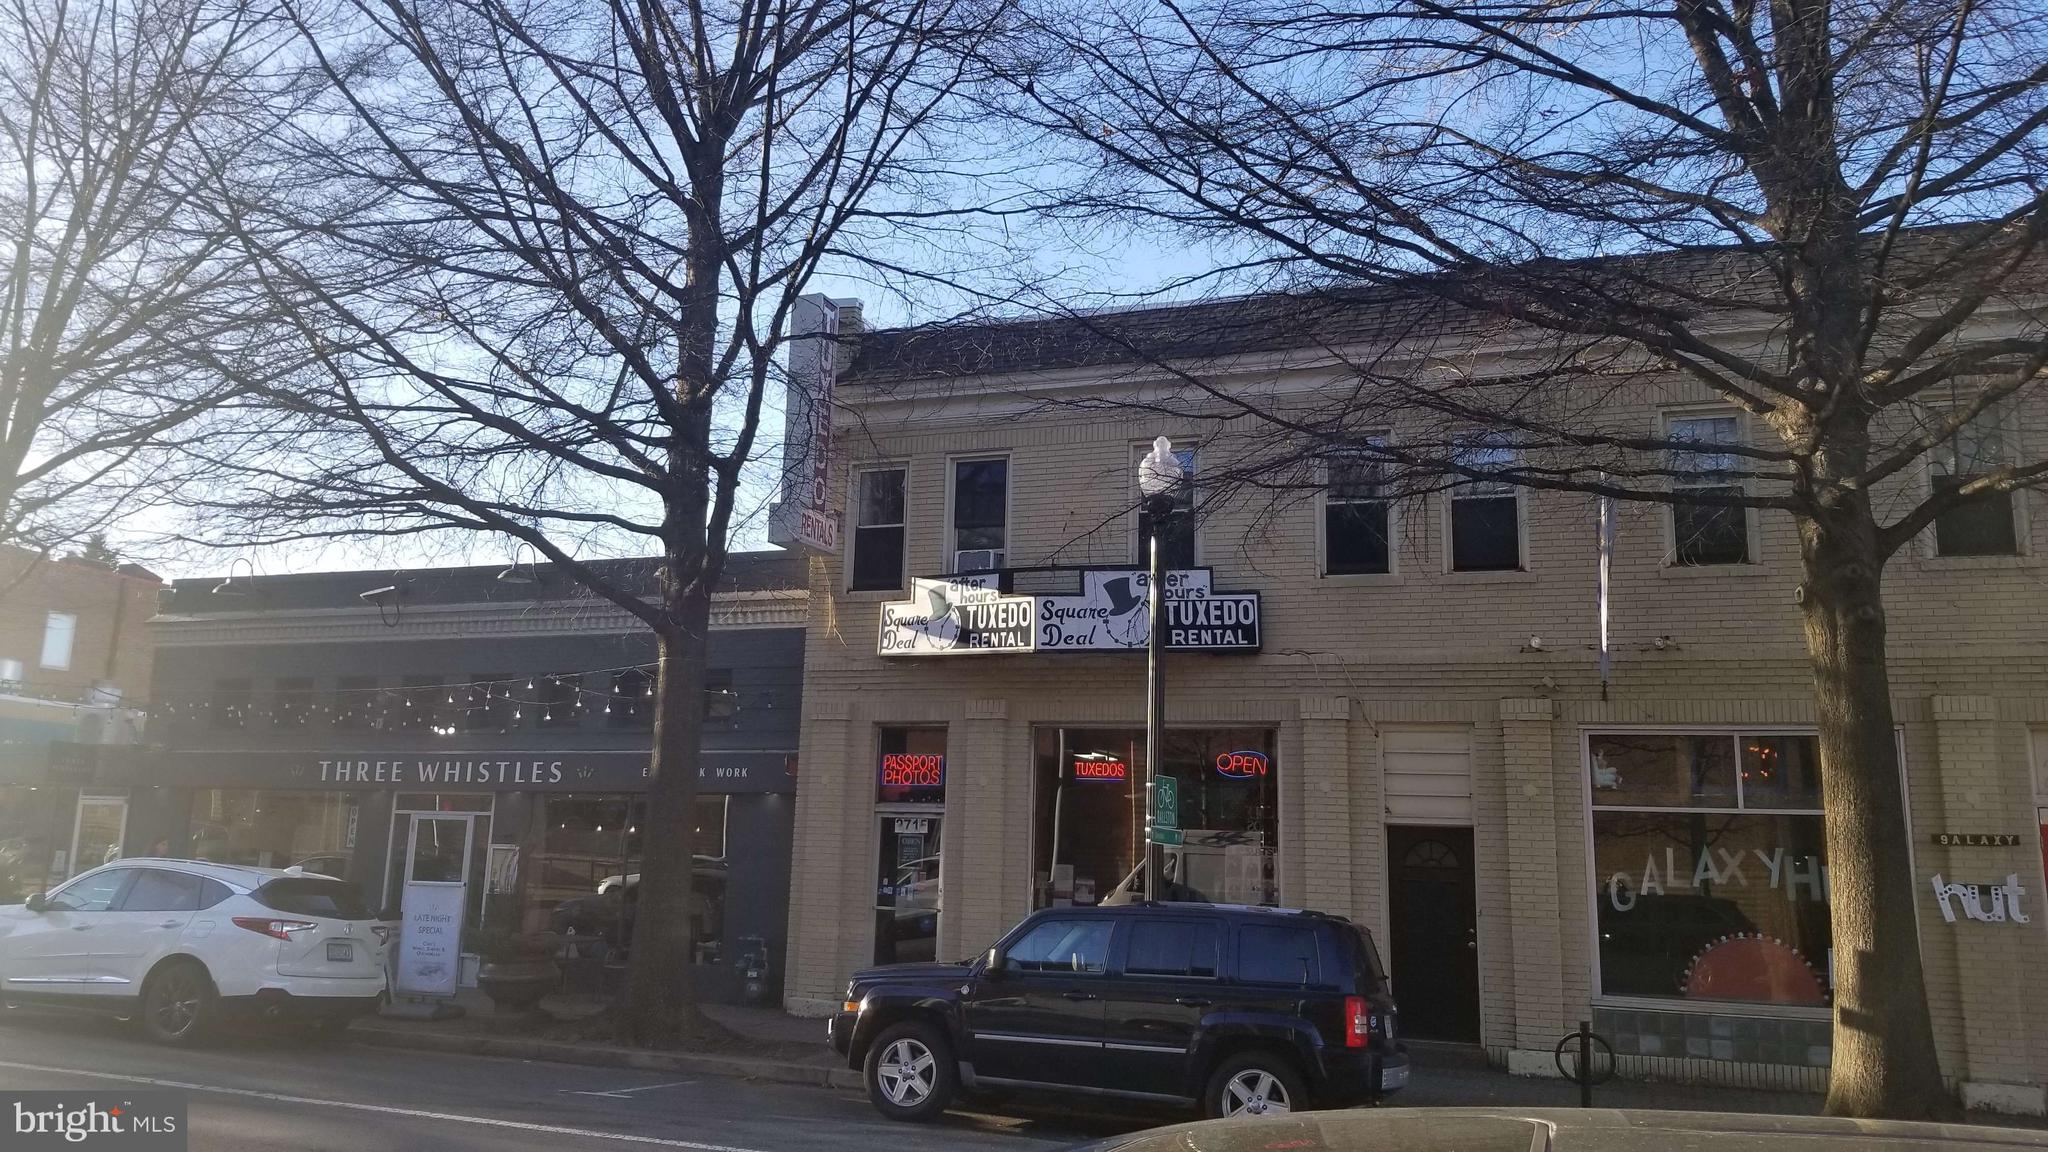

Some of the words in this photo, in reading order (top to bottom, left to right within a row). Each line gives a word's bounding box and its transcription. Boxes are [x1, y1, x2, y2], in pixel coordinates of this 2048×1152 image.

[801, 513, 834, 548] RENTALS
[1165, 585, 1208, 599] ours"
[886, 609, 928, 632] Square
[967, 602, 1031, 629] TUXEDO
[1040, 600, 1108, 624] Square
[1165, 600, 1255, 626] TUXEDO
[882, 630, 919, 650] Deal
[969, 631, 1025, 648] RENTAL
[1041, 623, 1097, 647] Deal
[1171, 629, 1248, 645] RENTAL
[319, 761, 403, 782] THREE
[418, 761, 562, 784] WHISTLES
[716, 767, 749, 778] WORK
[884, 755, 943, 770] PASSPORT
[1075, 761, 1125, 777] TUXEDOS
[1217, 753, 1268, 776] OPEN
[884, 769, 941, 785] PHOTOS
[1609, 843, 1784, 912] GALAXY
[1931, 872, 2030, 923] hut
